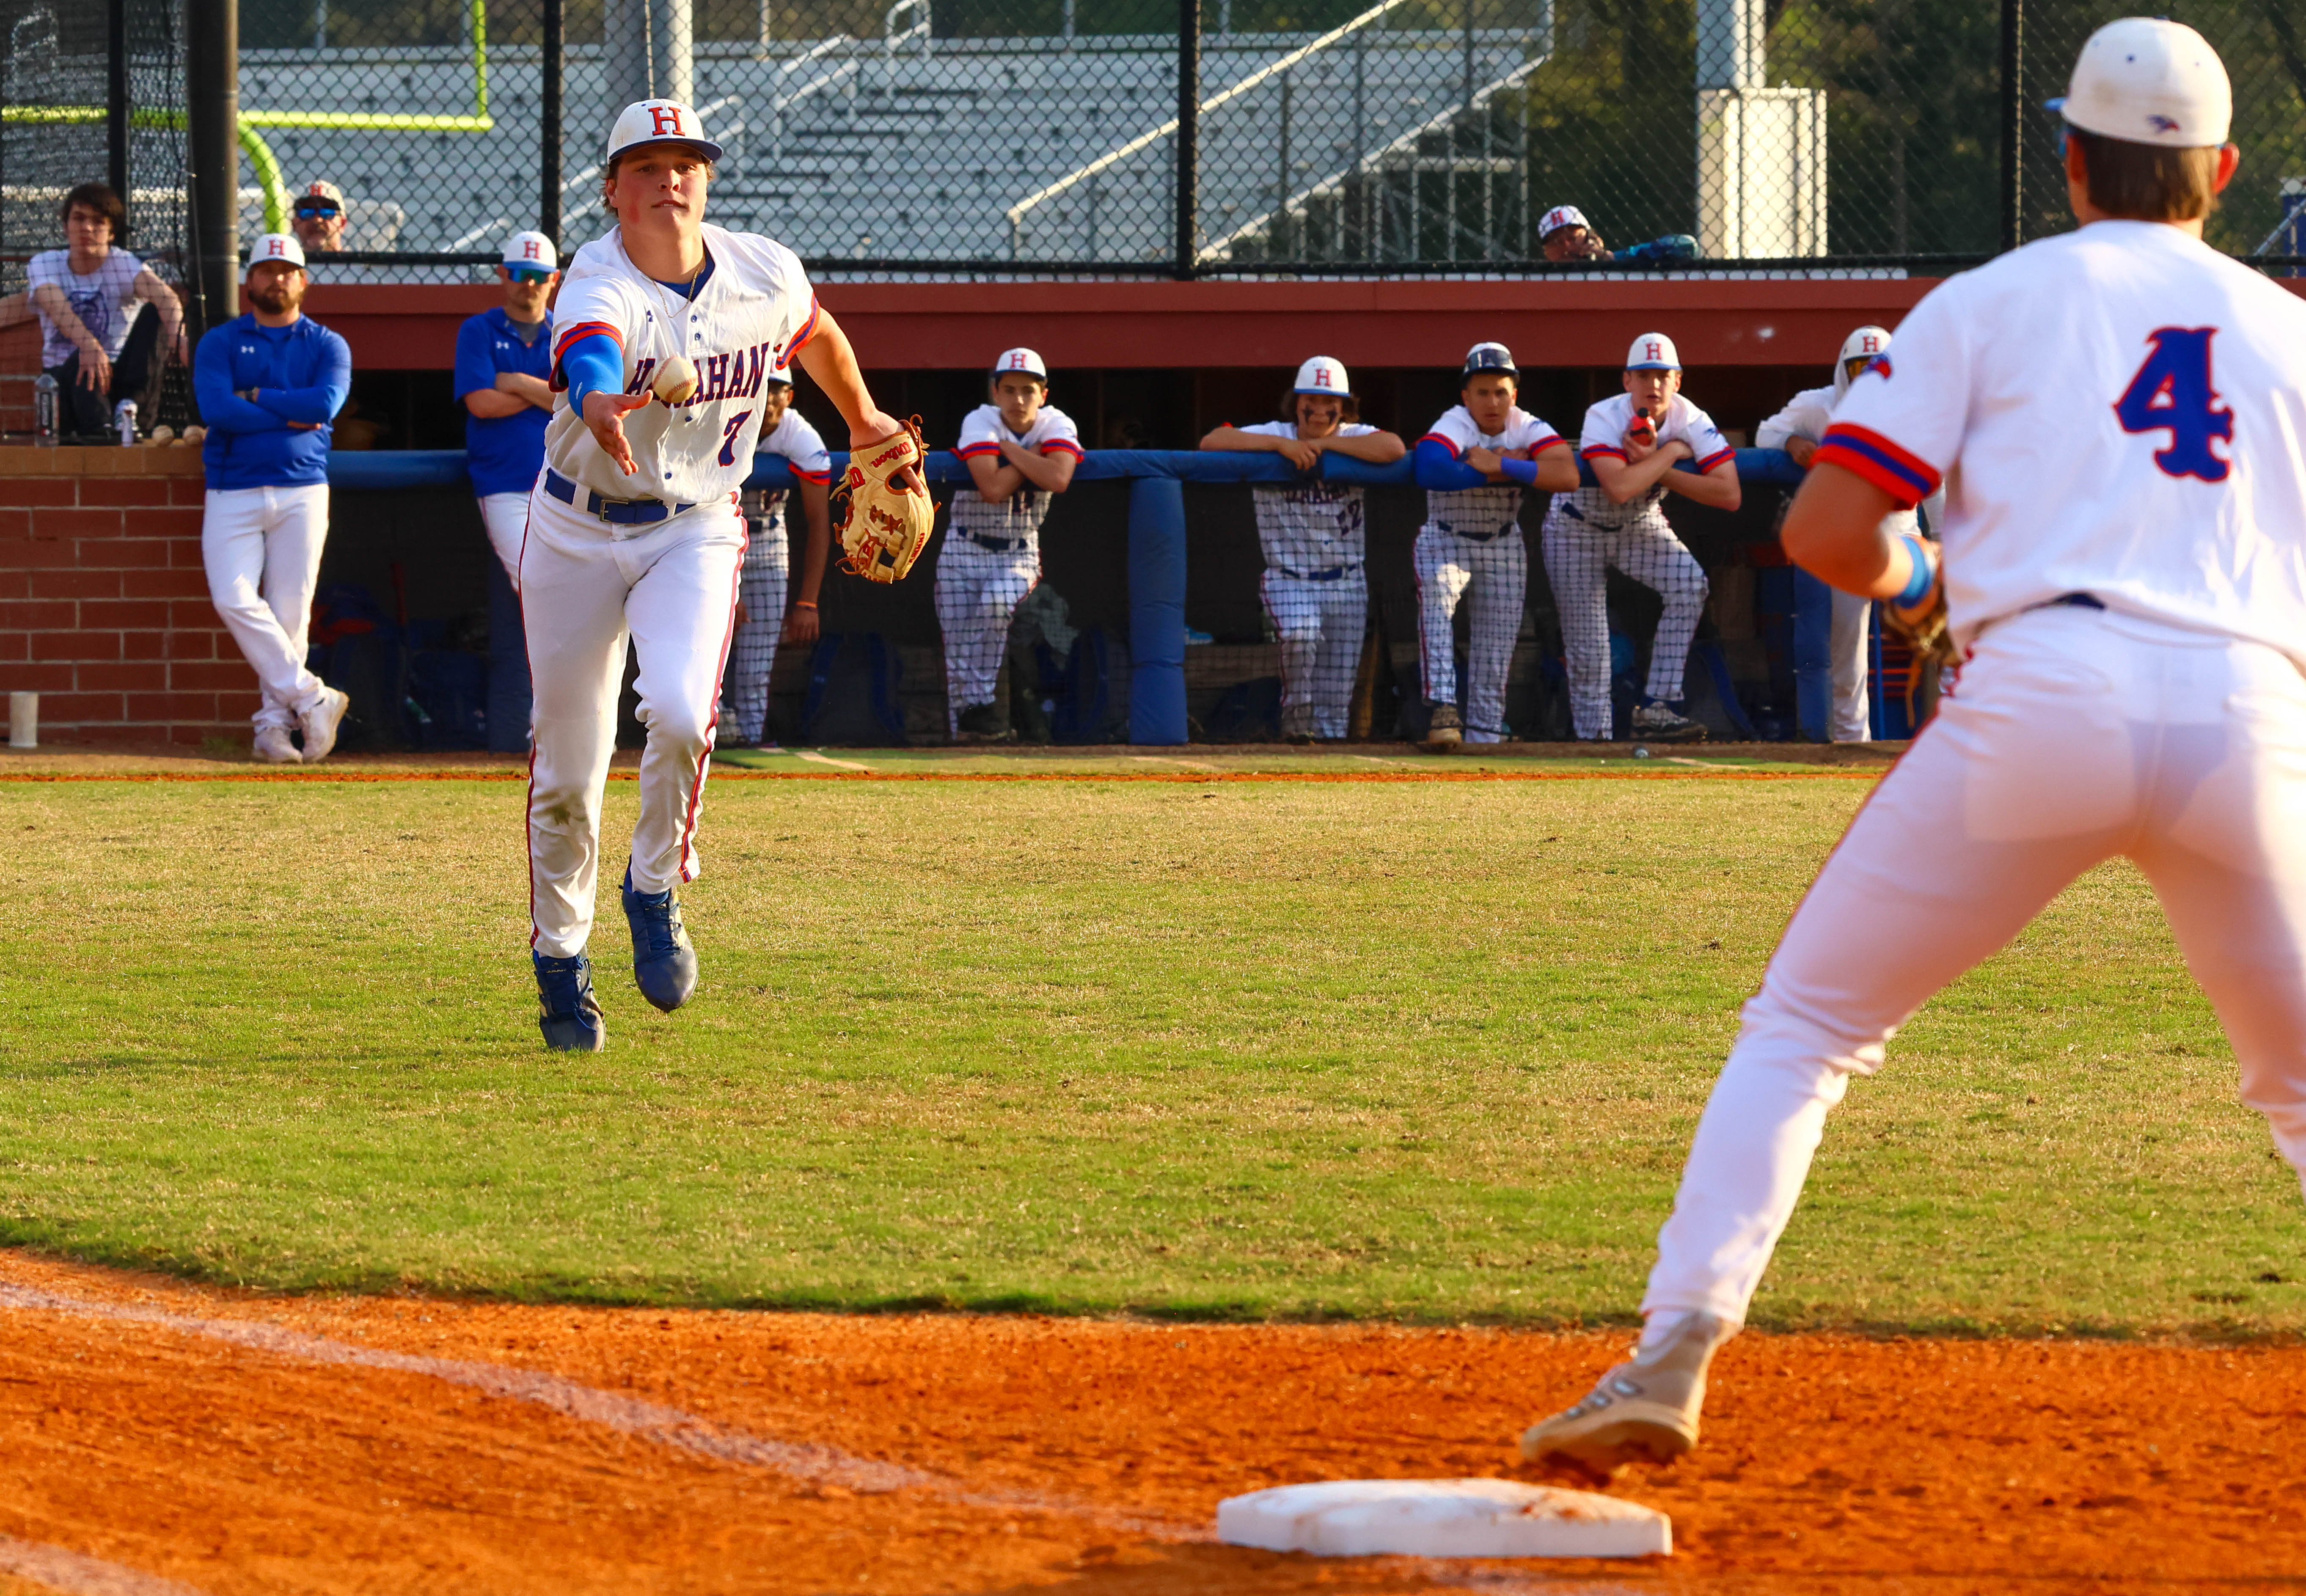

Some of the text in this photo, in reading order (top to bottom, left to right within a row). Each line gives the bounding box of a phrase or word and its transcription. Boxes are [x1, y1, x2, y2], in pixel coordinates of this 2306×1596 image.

[648, 106, 685, 136] H
[310, 184, 323, 196] H
[1550, 210, 1564, 226] H
[268, 239, 284, 256] H
[523, 240, 540, 259] H
[1645, 342, 1662, 360] H
[1863, 336, 1879, 352] H
[1010, 354, 1027, 369] H
[624, 342, 770, 408] HAHAN
[1314, 369, 1332, 386] H
[2112, 324, 2234, 482] 4
[718, 409, 752, 467] 7
[871, 441, 912, 468] Wilson
